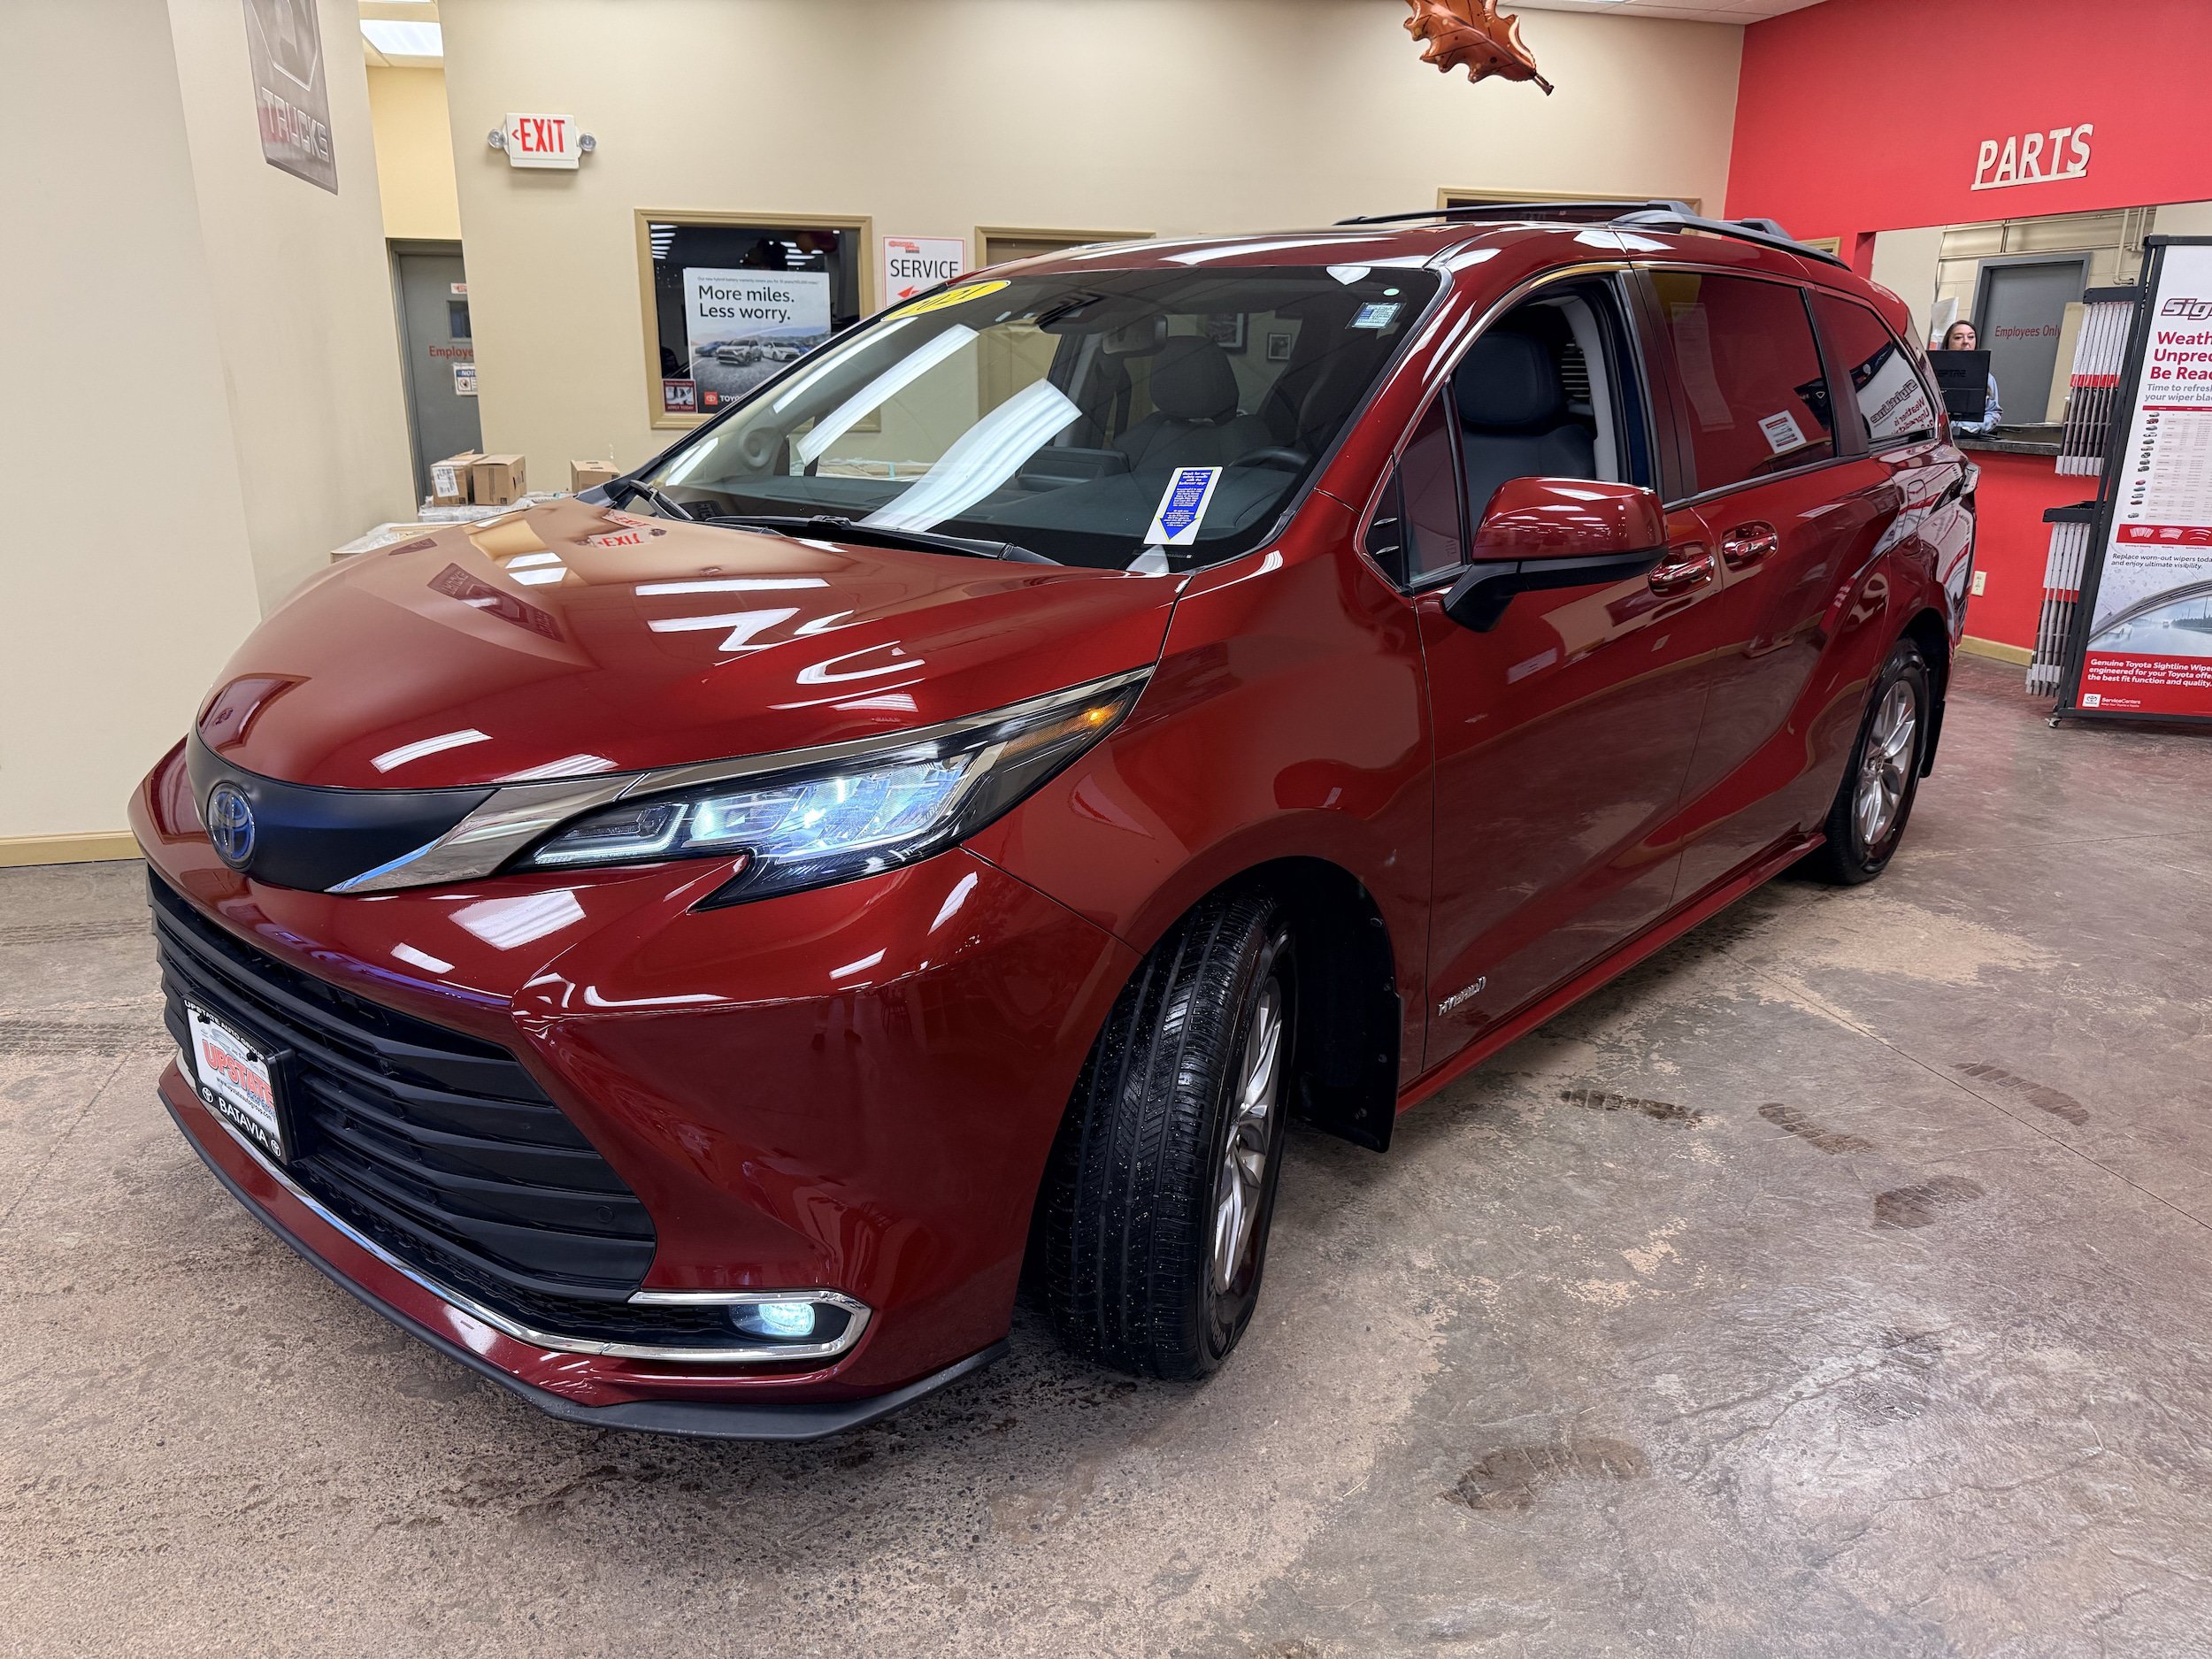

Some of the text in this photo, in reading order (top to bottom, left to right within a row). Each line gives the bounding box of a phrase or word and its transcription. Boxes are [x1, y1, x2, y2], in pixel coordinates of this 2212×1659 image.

[261, 86, 330, 163] TRUCKS
[519, 118, 565, 153] EXIT
[1973, 123, 2094, 185] PARTS
[890, 258, 958, 279] SERVICE
[698, 285, 795, 303] More miles.
[699, 303, 791, 324] Less worry.
[1995, 326, 2039, 340] Employees
[2150, 366, 2172, 380] Be
[2147, 383, 2170, 392] Time
[2168, 393, 2194, 403] wiper
[2112, 553, 2139, 562] Replace
[2089, 666, 2135, 676] engineered
[2091, 658, 2124, 667] Genuine
[2125, 661, 2152, 670] Toyota
[2153, 662, 2189, 671] Sightline
[2131, 675, 2165, 685] function
[202, 1038, 274, 1110] UPSTATE
[218, 1096, 269, 1148] BATAVIA
